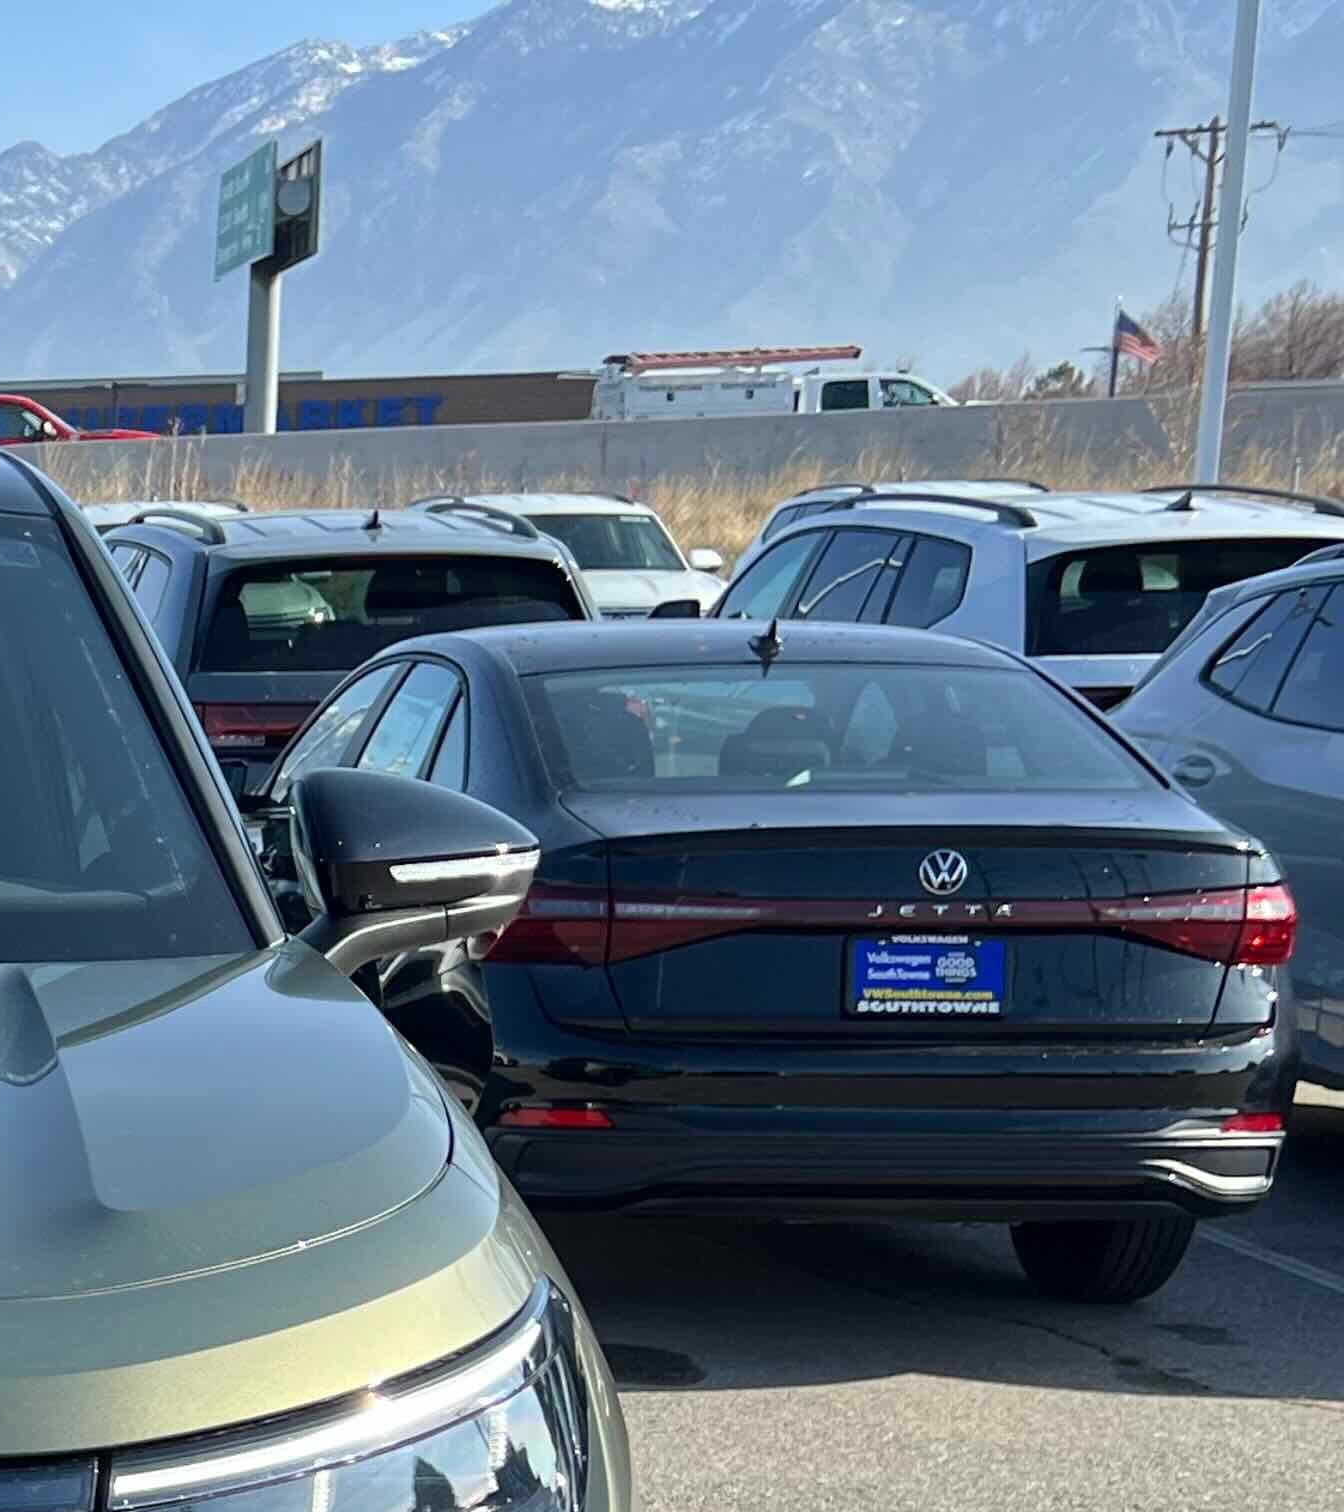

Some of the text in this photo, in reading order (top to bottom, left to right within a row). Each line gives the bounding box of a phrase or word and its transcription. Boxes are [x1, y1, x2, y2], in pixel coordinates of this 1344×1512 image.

[919, 849, 968, 895] VW
[868, 903, 1013, 918] JETTA
[891, 934, 969, 944] VOLKSWAGEN
[867, 951, 931, 966] Volkswagen
[857, 1000, 1000, 1014] SOUTHTOWNE
